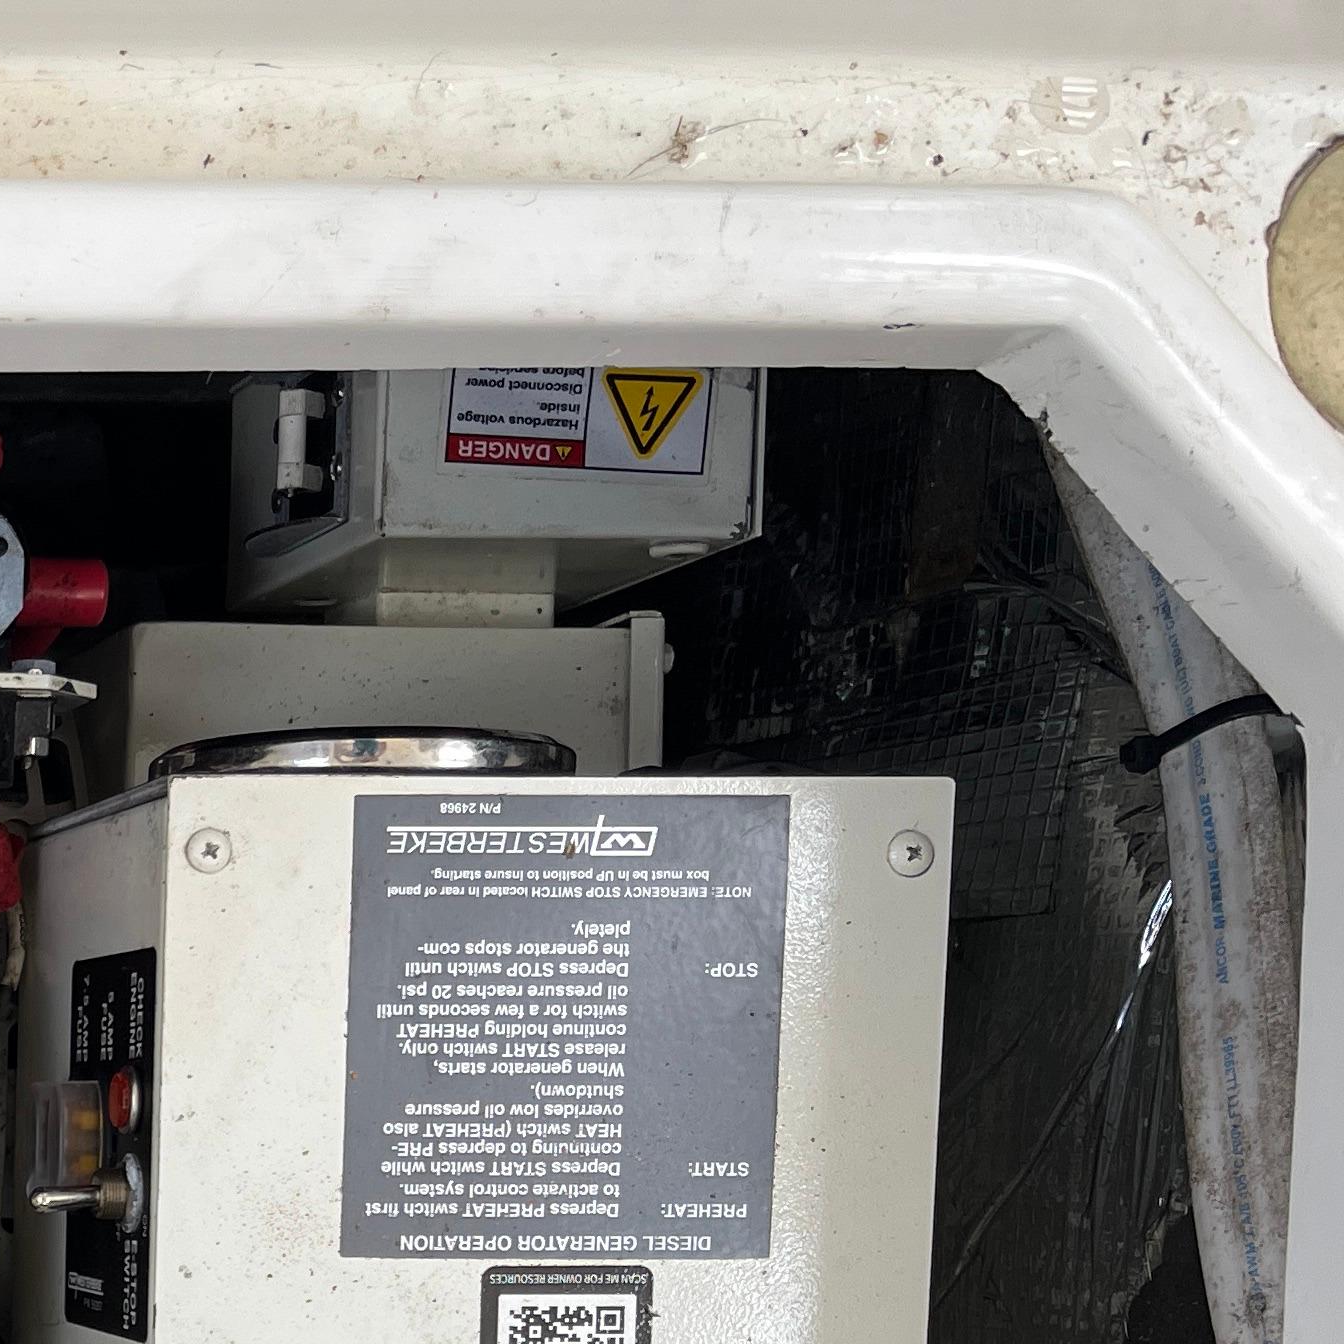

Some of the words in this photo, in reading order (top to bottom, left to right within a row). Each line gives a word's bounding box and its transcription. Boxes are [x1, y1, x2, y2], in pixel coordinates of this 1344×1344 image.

[465, 378, 505, 388] power
[508, 380, 582, 394] Disconnect
[537, 402, 580, 414] inside.
[457, 412, 504, 425] voltage
[509, 416, 578, 430] Hazardous
[459, 440, 550, 460] DANGER
[440, 803, 476, 813] 24968
[480, 803, 501, 814] P/N
[1197, 792, 1217, 852] GRADE
[387, 832, 589, 853] WESTERBEKE
[431, 868, 481, 881] starting.
[485, 870, 523, 881] insure
[527, 871, 539, 880] to
[543, 868, 593, 881] position
[596, 870, 614, 881] UP
[618, 870, 629, 881] in
[632, 870, 648, 881] be
[652, 870, 682, 880] must
[686, 871, 709, 881] box
[388, 884, 421, 897] panel
[424, 887, 437, 897] of
[440, 887, 464, 895] rear
[468, 887, 479, 897] in
[483, 887, 528, 897] located
[532, 887, 582, 898] SWITCH
[586, 887, 620, 898] STOP
[624, 887, 707, 898] EMERGENCY
[712, 887, 751, 898] NOTE:
[1208, 855, 1226, 929] MARINE
[572, 920, 630, 938] pletely.
[418, 943, 460, 954] com-
[465, 940, 512, 956] stops
[516, 940, 598, 956] generator
[603, 943, 630, 957] the
[406, 962, 442, 976] until
[448, 962, 502, 977] switch
[507, 963, 554, 977] STOP
[559, 959, 628, 977] Depress
[705, 963, 758, 977] STOP:
[398, 982, 426, 999] psi.
[432, 985, 452, 999] 20
[457, 985, 522, 999] reaches
[528, 982, 602, 996] pressure
[608, 985, 628, 999] oil
[129, 973, 137, 1059] ENGINE
[136, 977, 144, 1057] CHECK
[377, 1004, 413, 1018] until
[419, 1004, 490, 1018] seconds
[495, 1004, 524, 1019] few
[530, 1005, 539, 1015] a
[544, 1005, 567, 1019] for
[573, 1005, 627, 1019] switch
[396, 1024, 479, 1038] PREHEAT
[485, 1021, 548, 1038] holding
[552, 1024, 626, 1038] continue
[399, 1040, 438, 1056] only.
[444, 1043, 498, 1057] switch
[502, 1043, 560, 1057] START
[565, 1043, 625, 1057] release
[434, 1060, 486, 1075] starts,
[490, 1059, 572, 1076] generator
[578, 1062, 624, 1077] When
[531, 1082, 624, 1099] shutdown).
[405, 1102, 480, 1115] pressure
[485, 1104, 505, 1118] oil
[510, 1104, 538, 1118] low
[544, 1104, 623, 1118] overrides
[383, 1123, 418, 1137] also
[423, 1120, 511, 1138] (PREHEAT
[517, 1123, 570, 1137] switch
[575, 1124, 622, 1138] HEAT
[392, 1142, 433, 1156] PRE-
[439, 1140, 505, 1156] depress
[511, 1143, 527, 1156] to
[532, 1140, 621, 1156] continuing
[381, 1161, 425, 1176] while
[431, 1162, 485, 1176] switch
[489, 1162, 546, 1176] START
[552, 1158, 620, 1176] Depress
[689, 1162, 749, 1176] START:
[400, 1181, 464, 1197] system.
[470, 1184, 528, 1198] control
[533, 1181, 598, 1198] activate
[603, 1184, 620, 1197] to
[366, 1203, 399, 1217] first
[404, 1203, 458, 1217] switch
[462, 1203, 544, 1217] PREHEAT
[550, 1200, 618, 1217] Depress
[661, 1204, 746, 1218] PREHEAT:
[400, 1235, 512, 1251] OPERATION
[518, 1236, 637, 1251] GENERATOR
[643, 1236, 711, 1251] DIESEL
[123, 1239, 131, 1330] SWITCH
[130, 1239, 138, 1326] E-STOP
[490, 1274, 545, 1284] RESOURCES
[548, 1274, 582, 1283] OWNER
[584, 1274, 603, 1283] FOR
[605, 1274, 619, 1283] ME
[621, 1274, 648, 1284] SCAN
